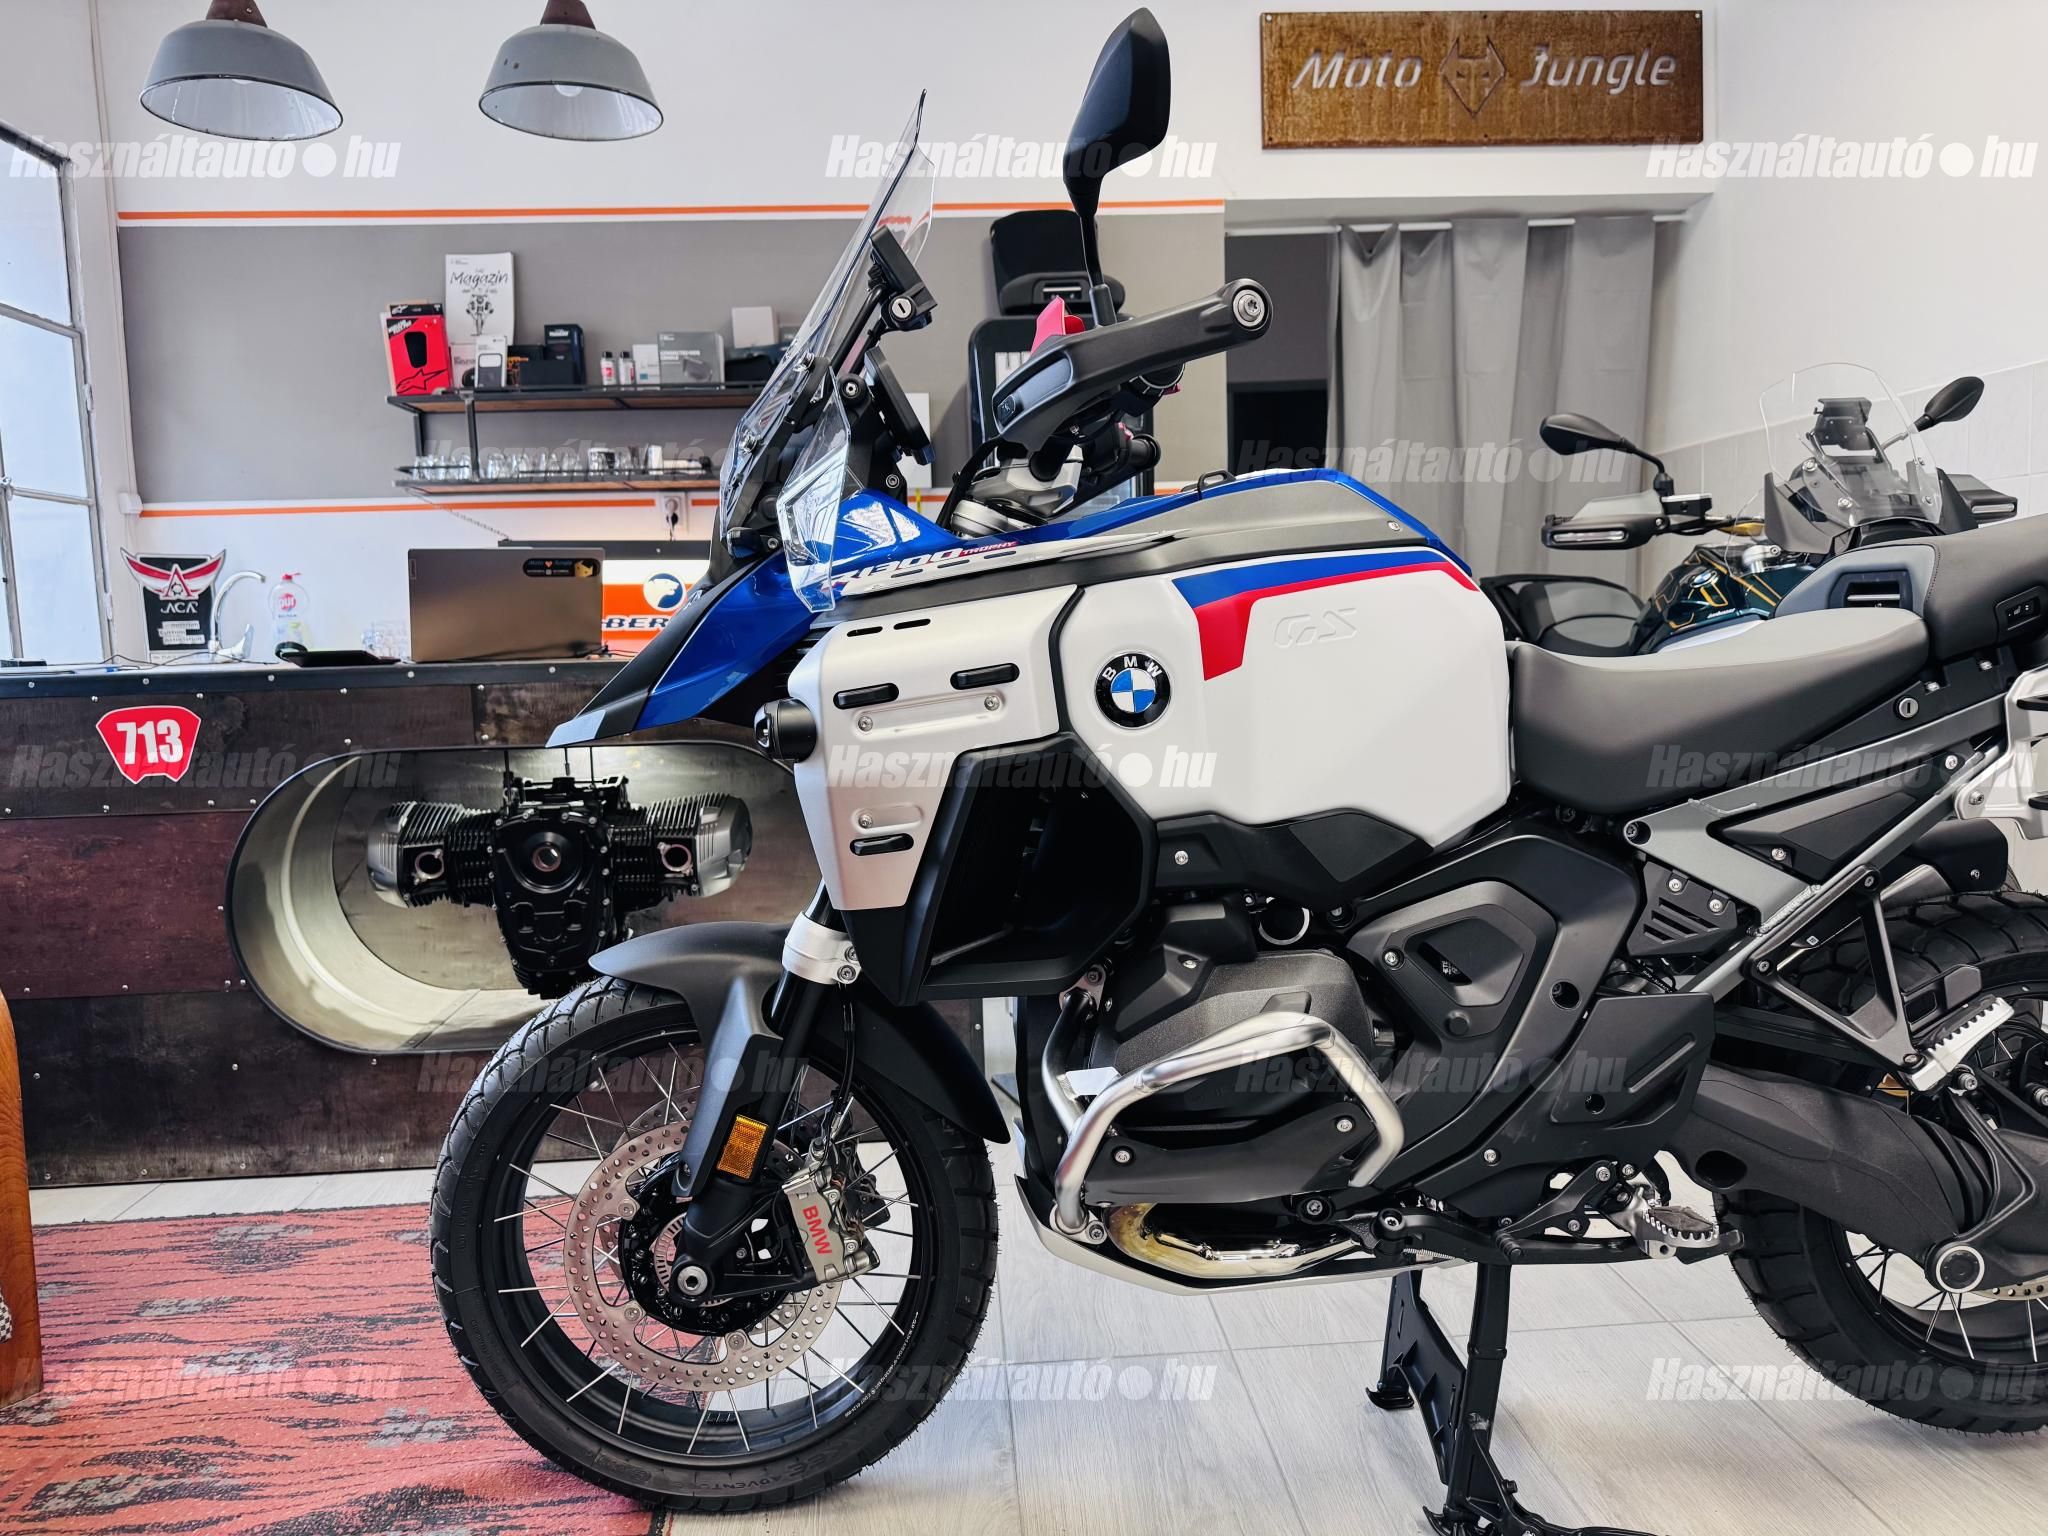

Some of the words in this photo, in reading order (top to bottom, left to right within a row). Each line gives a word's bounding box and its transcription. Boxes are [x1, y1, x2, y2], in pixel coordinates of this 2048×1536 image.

[1292, 49, 1423, 89] Moto
[1520, 43, 1677, 95] Jungle
[449, 270, 509, 289] Magazin
[960, 540, 1020, 558] TROPHY
[160, 601, 199, 614] ACA
[1102, 656, 1163, 681] BMW
[116, 718, 183, 765] 713
[803, 1205, 833, 1254] BMW
